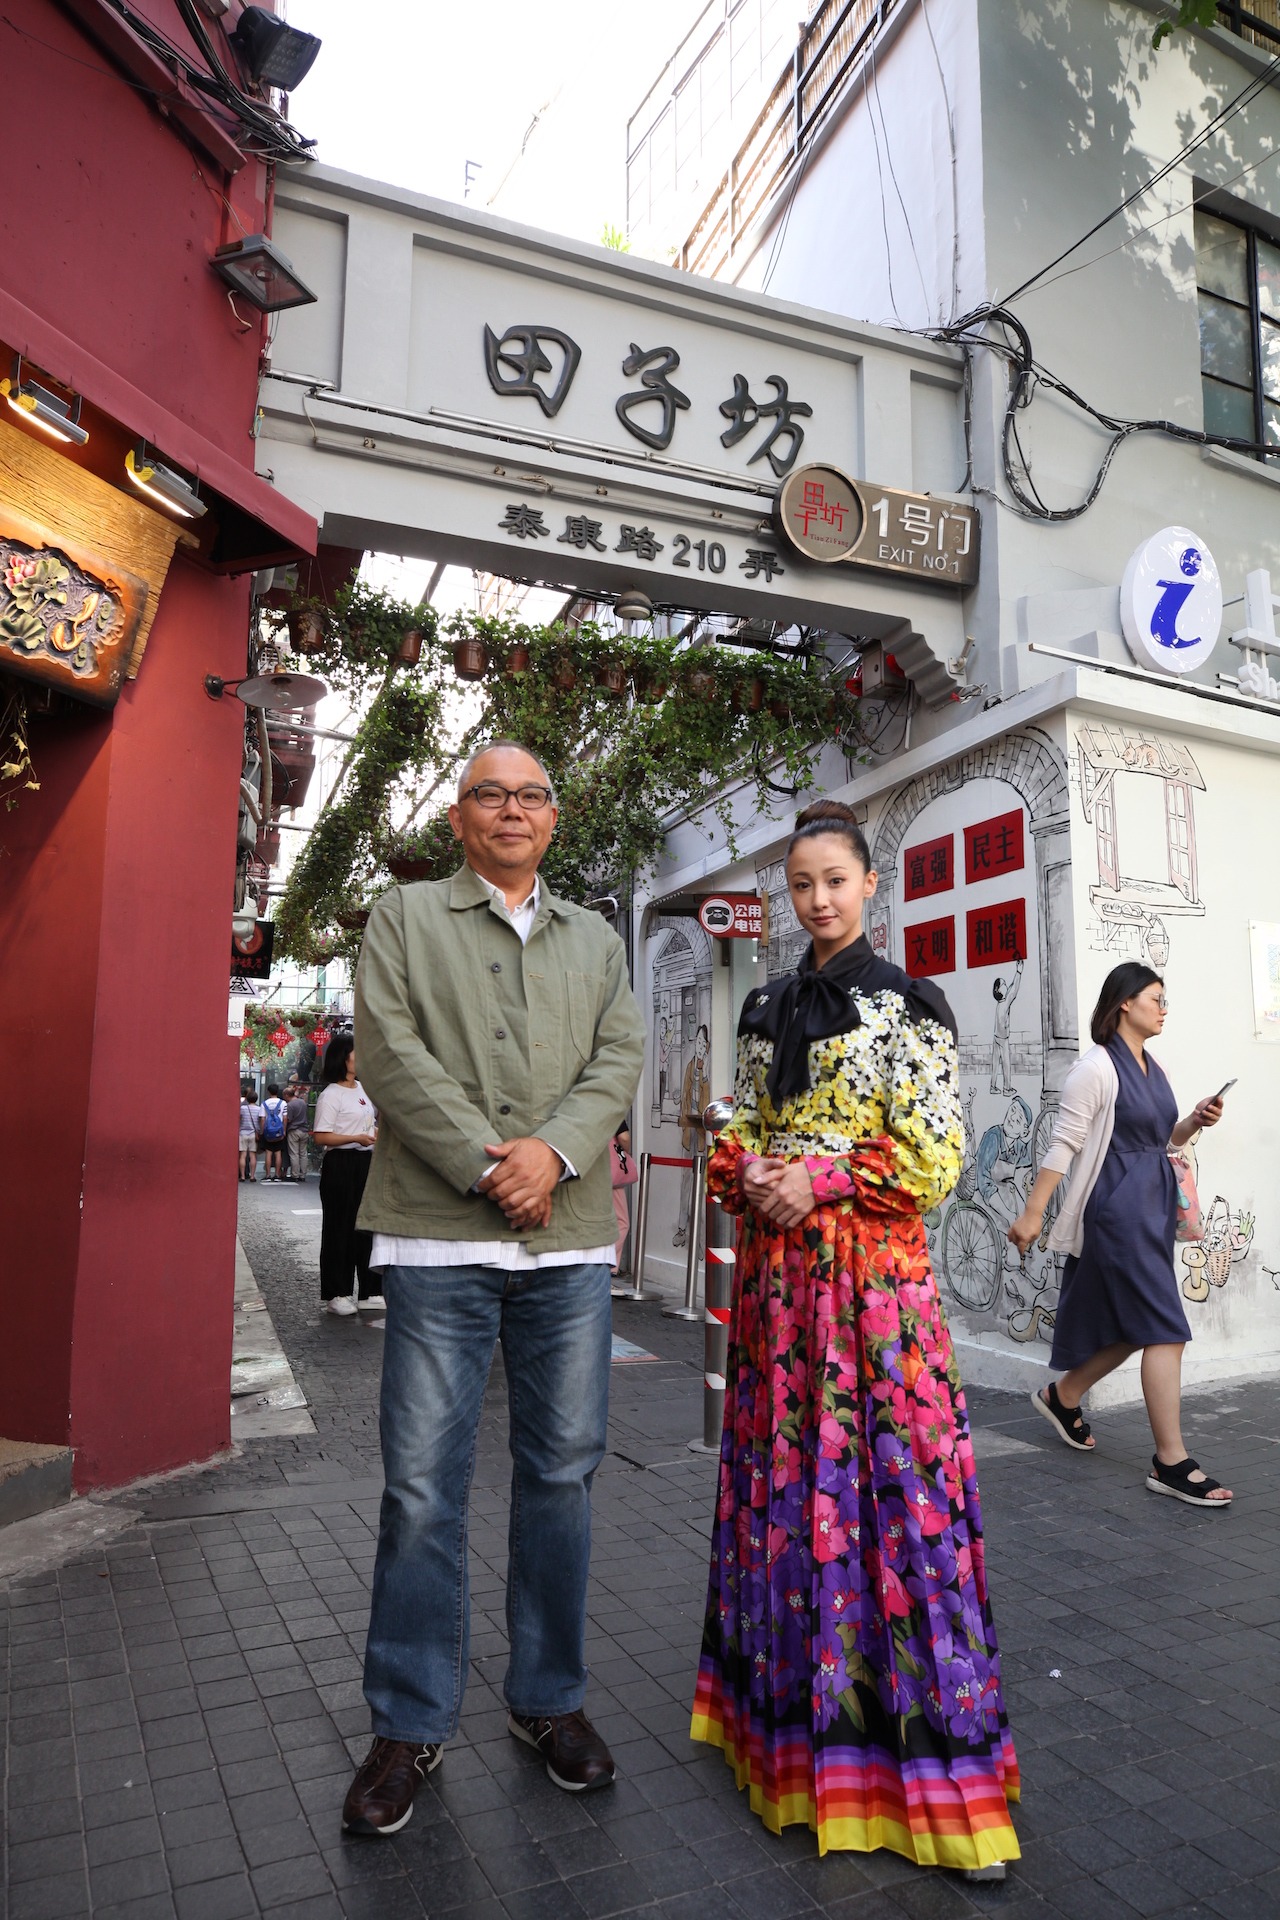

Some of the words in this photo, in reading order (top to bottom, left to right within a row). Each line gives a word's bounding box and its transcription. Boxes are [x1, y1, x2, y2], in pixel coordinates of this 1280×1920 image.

[484, 322, 814, 478] 田子坊
[794, 481, 849, 537] 田子坊
[871, 497, 972, 555] 1号门
[878, 544, 915, 565] EXIT
[923, 553, 960, 575] NO.1
[910, 848, 947, 890] 富强
[973, 826, 1015, 871] 民主
[734, 904, 762, 918] 公用
[734, 919, 762, 933] 电话
[911, 928, 949, 967] 文明
[975, 912, 1017, 956] 和谐
